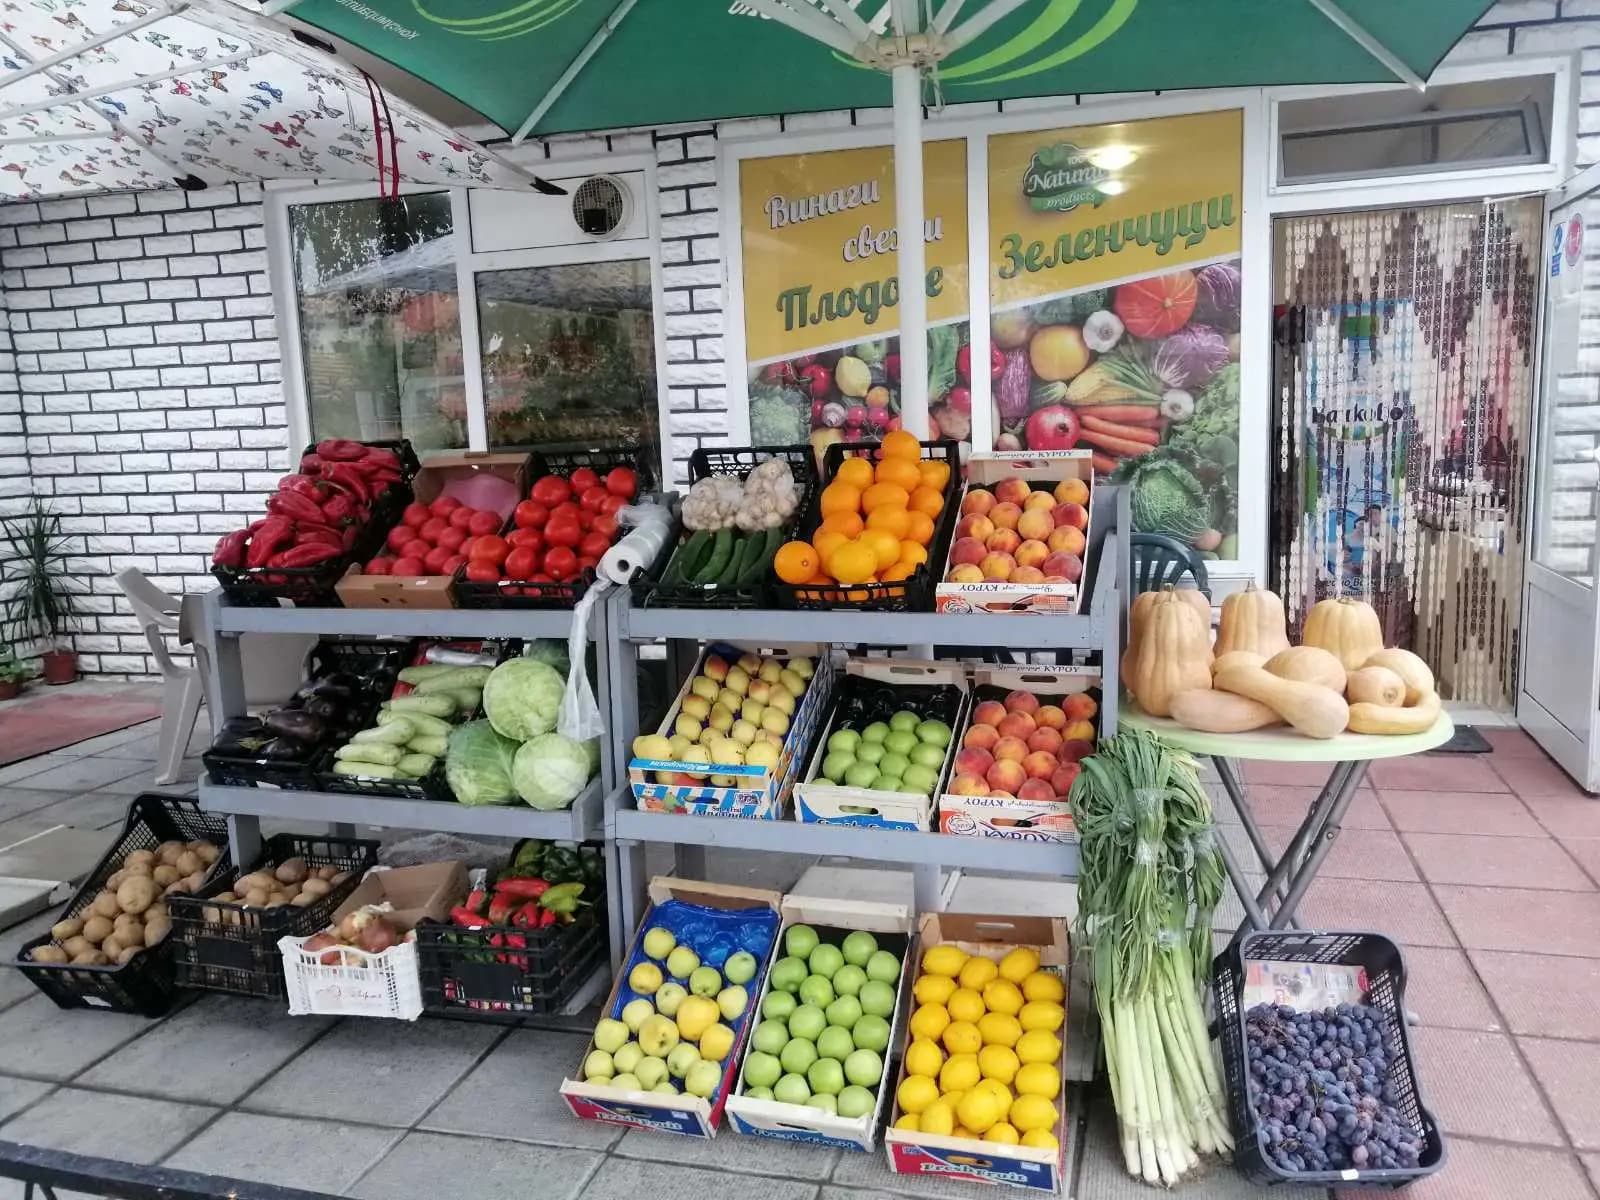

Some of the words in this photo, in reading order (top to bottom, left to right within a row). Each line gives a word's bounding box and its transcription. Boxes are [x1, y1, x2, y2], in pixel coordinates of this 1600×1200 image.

[764, 179, 880, 229] Винаги
[999, 193, 1236, 279] Зеленчуци
[776, 266, 944, 331] Плодое
